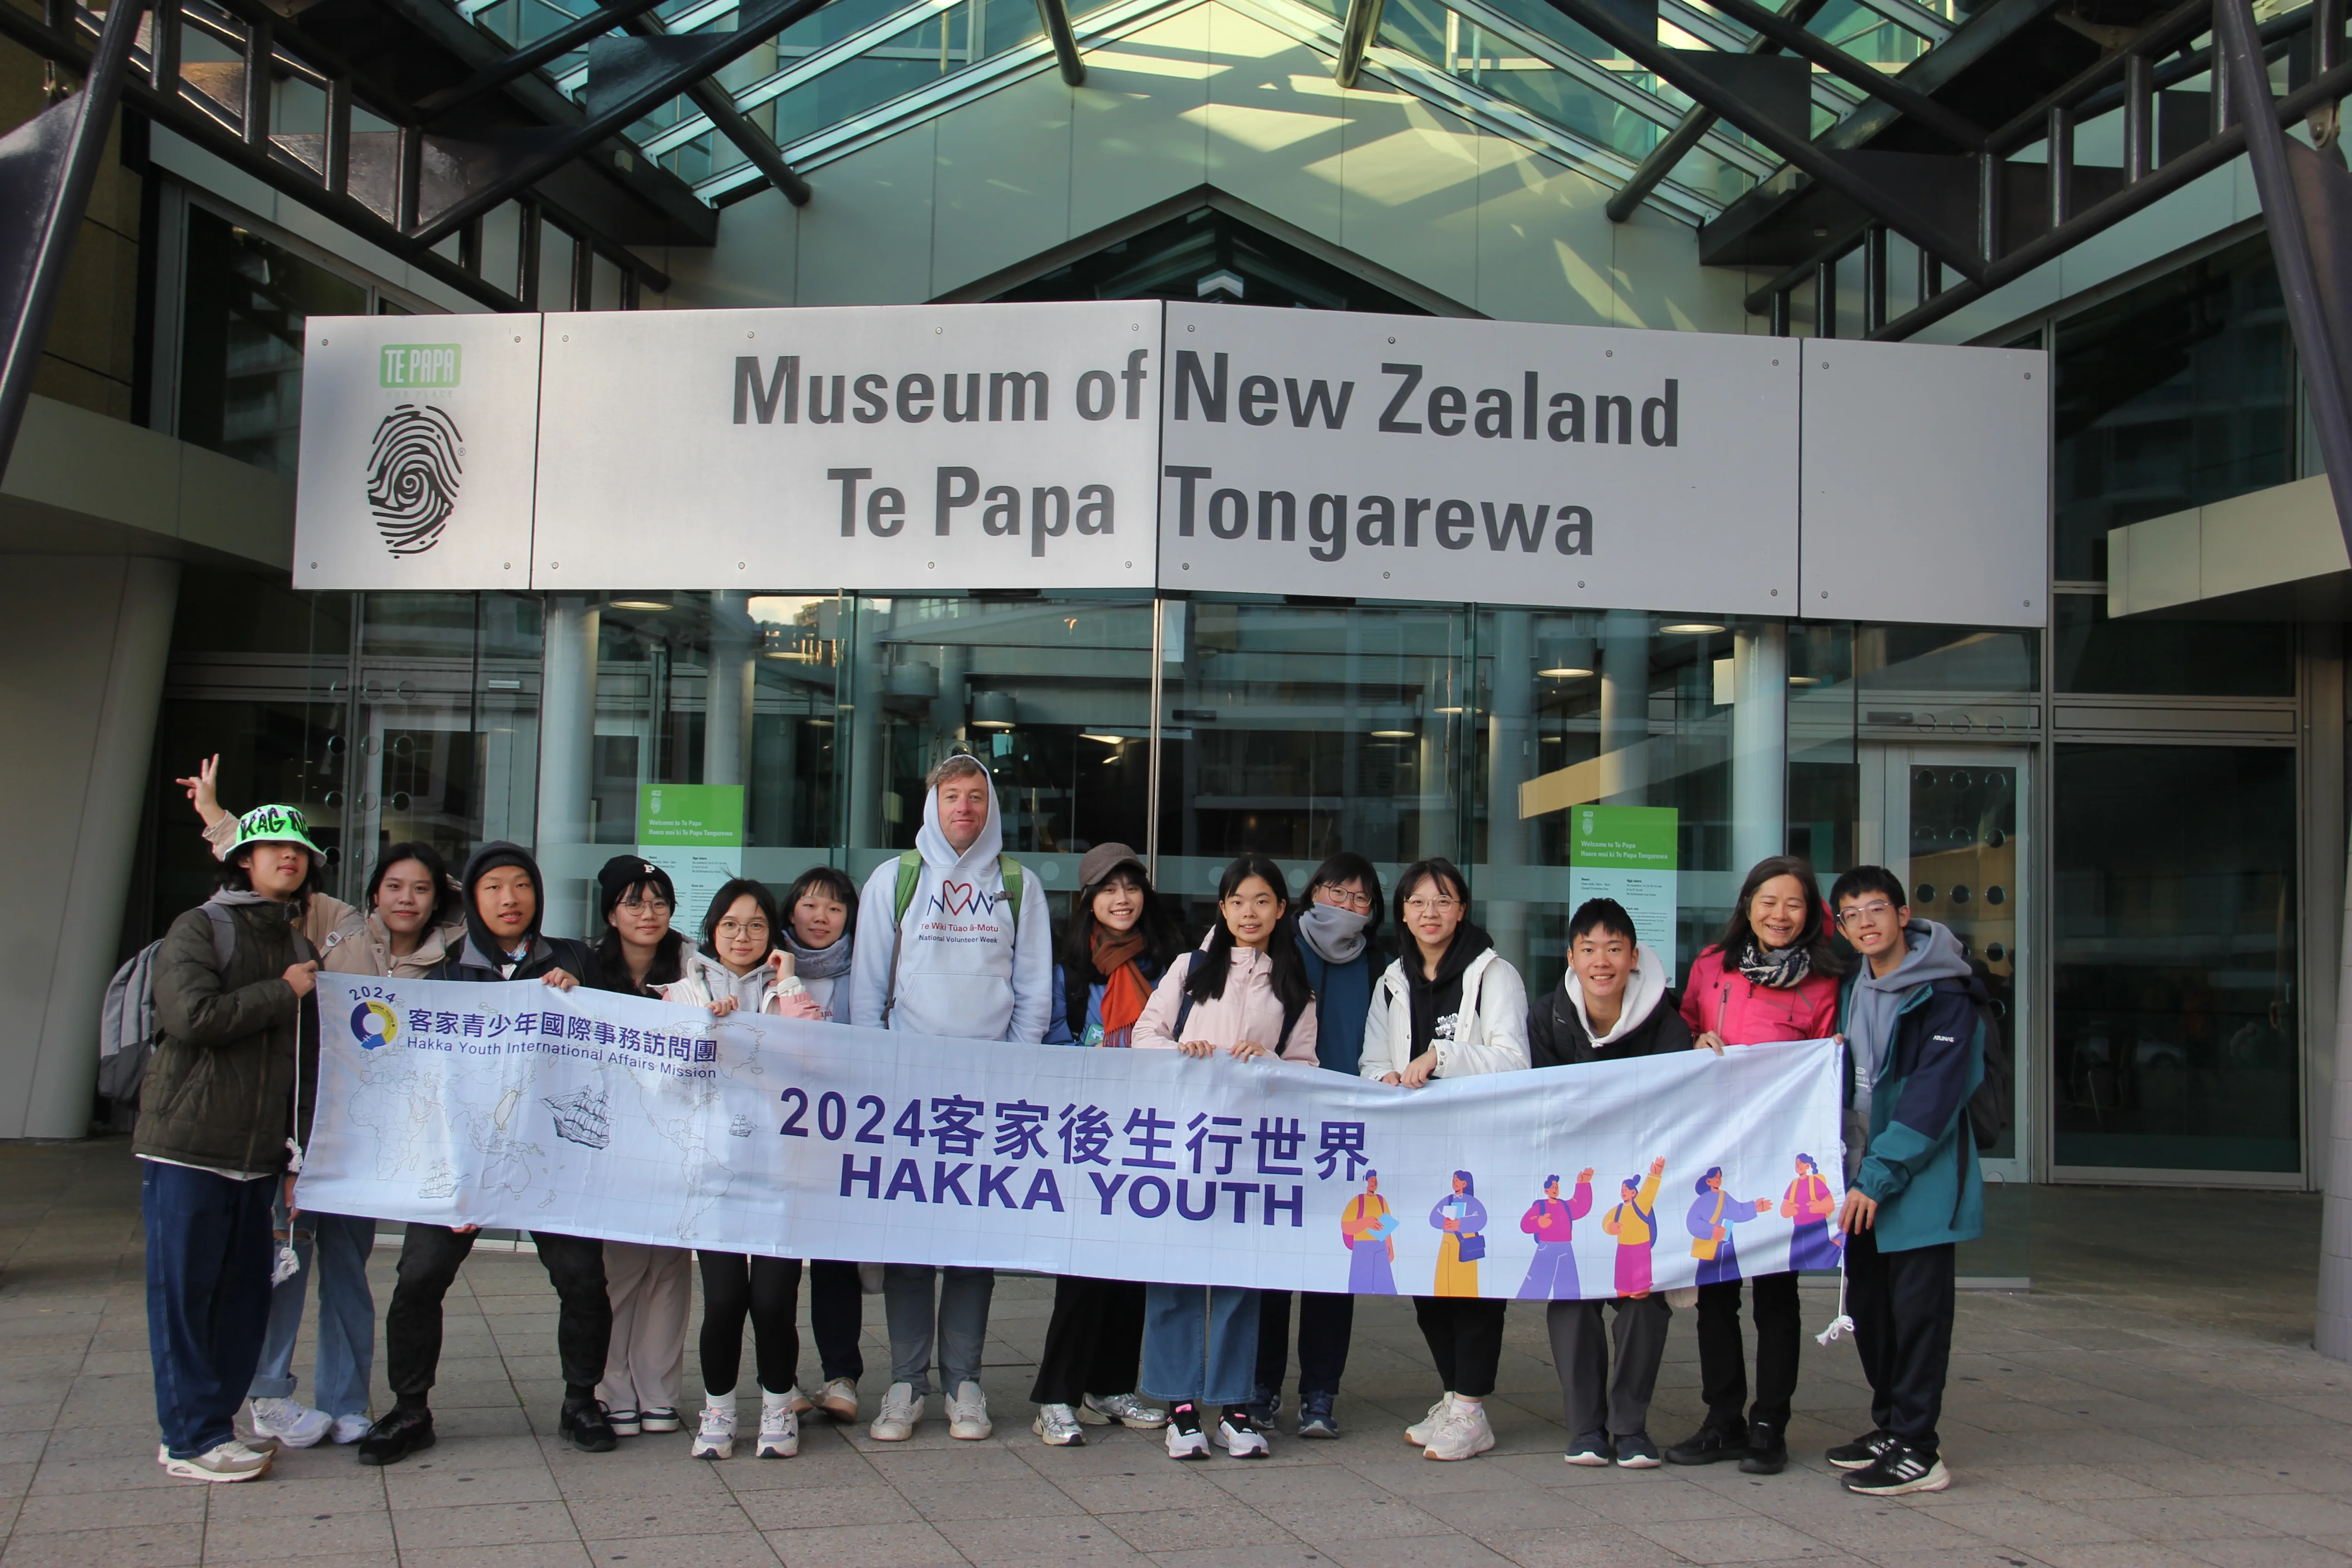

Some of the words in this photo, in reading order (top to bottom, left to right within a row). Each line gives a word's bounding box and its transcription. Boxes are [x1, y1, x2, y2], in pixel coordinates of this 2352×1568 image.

[385, 349, 406, 382] TE
[410, 349, 454, 382] PAPA
[733, 355, 1049, 425] Museum
[1076, 348, 1148, 421] of
[1174, 349, 1355, 430] New
[1378, 362, 1679, 448] Zealand
[827, 467, 905, 538] Te
[936, 466, 1113, 558] Papa
[1164, 465, 1593, 563] Tongarewa
[643, 864, 655, 873] P
[931, 922, 946, 931] Wiki
[948, 924, 967, 932] Tūao
[349, 986, 396, 1003] 2024
[386, 1010, 394, 1023] YOUTH
[409, 1008, 717, 1063] 客家青少年國際事務訪問團
[407, 1037, 452, 1051] Hakka
[459, 1041, 501, 1055] Youth
[507, 1042, 603, 1061] International
[608, 1052, 656, 1071] Affairs
[661, 1062, 716, 1078] Mission
[779, 1087, 1370, 1182] 2024客家後生行世界
[839, 1153, 1065, 1213] HAKKA
[1088, 1171, 1303, 1228] YOUTH
